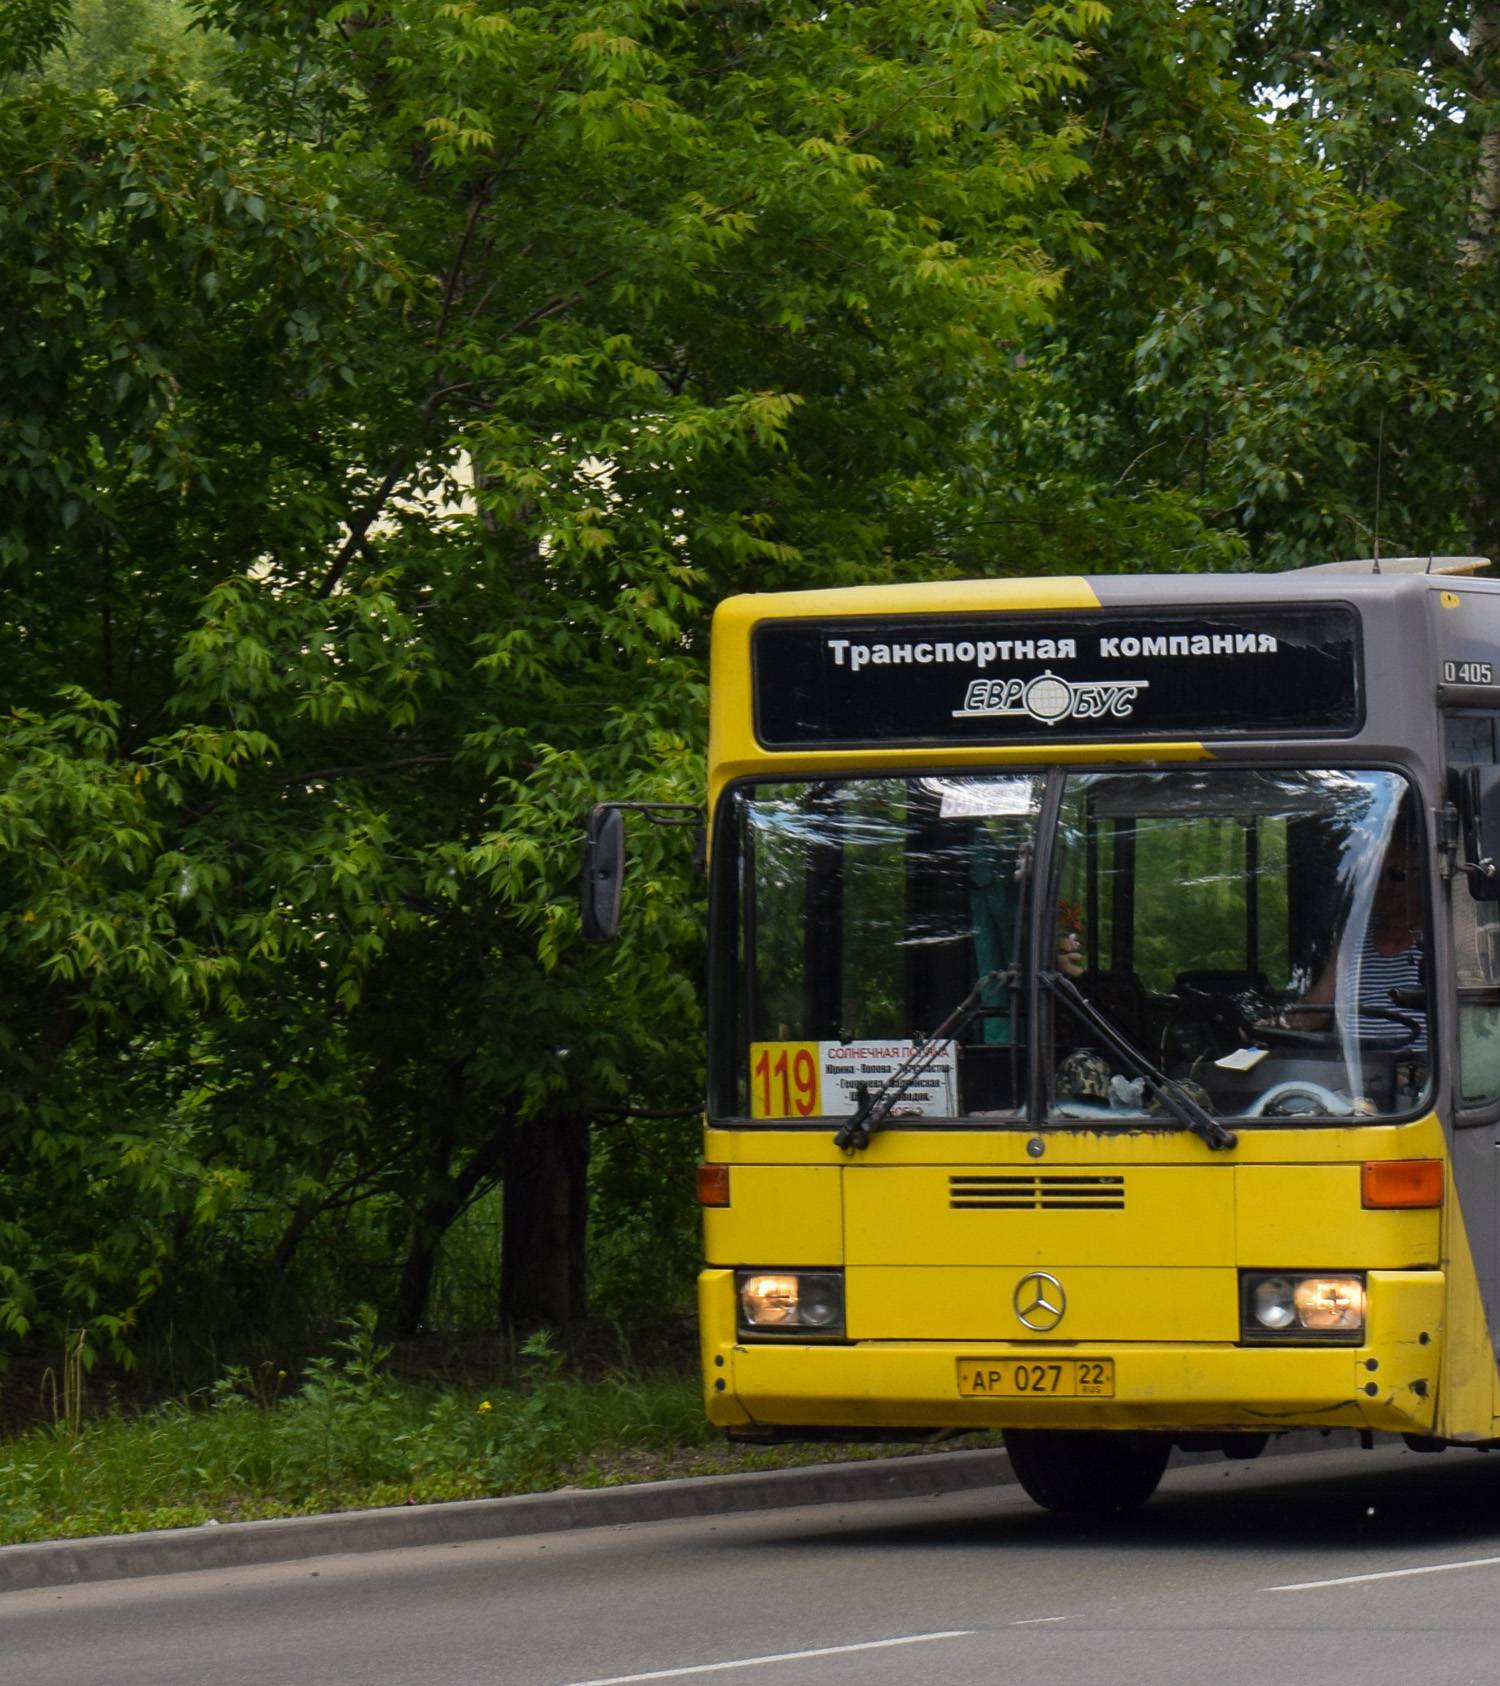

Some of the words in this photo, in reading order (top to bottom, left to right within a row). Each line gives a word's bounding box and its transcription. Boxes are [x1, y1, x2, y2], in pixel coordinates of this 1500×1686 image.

[828, 638, 1076, 671] Транспортная
[1100, 633, 1278, 658] компания
[1458, 663, 1491, 683] 405
[828, 1047, 899, 1059] СОЛНЕЧНАЯ
[756, 1048, 817, 1117] 119
[1014, 1365, 1063, 1392] 027
[1079, 1363, 1104, 1384] 22
